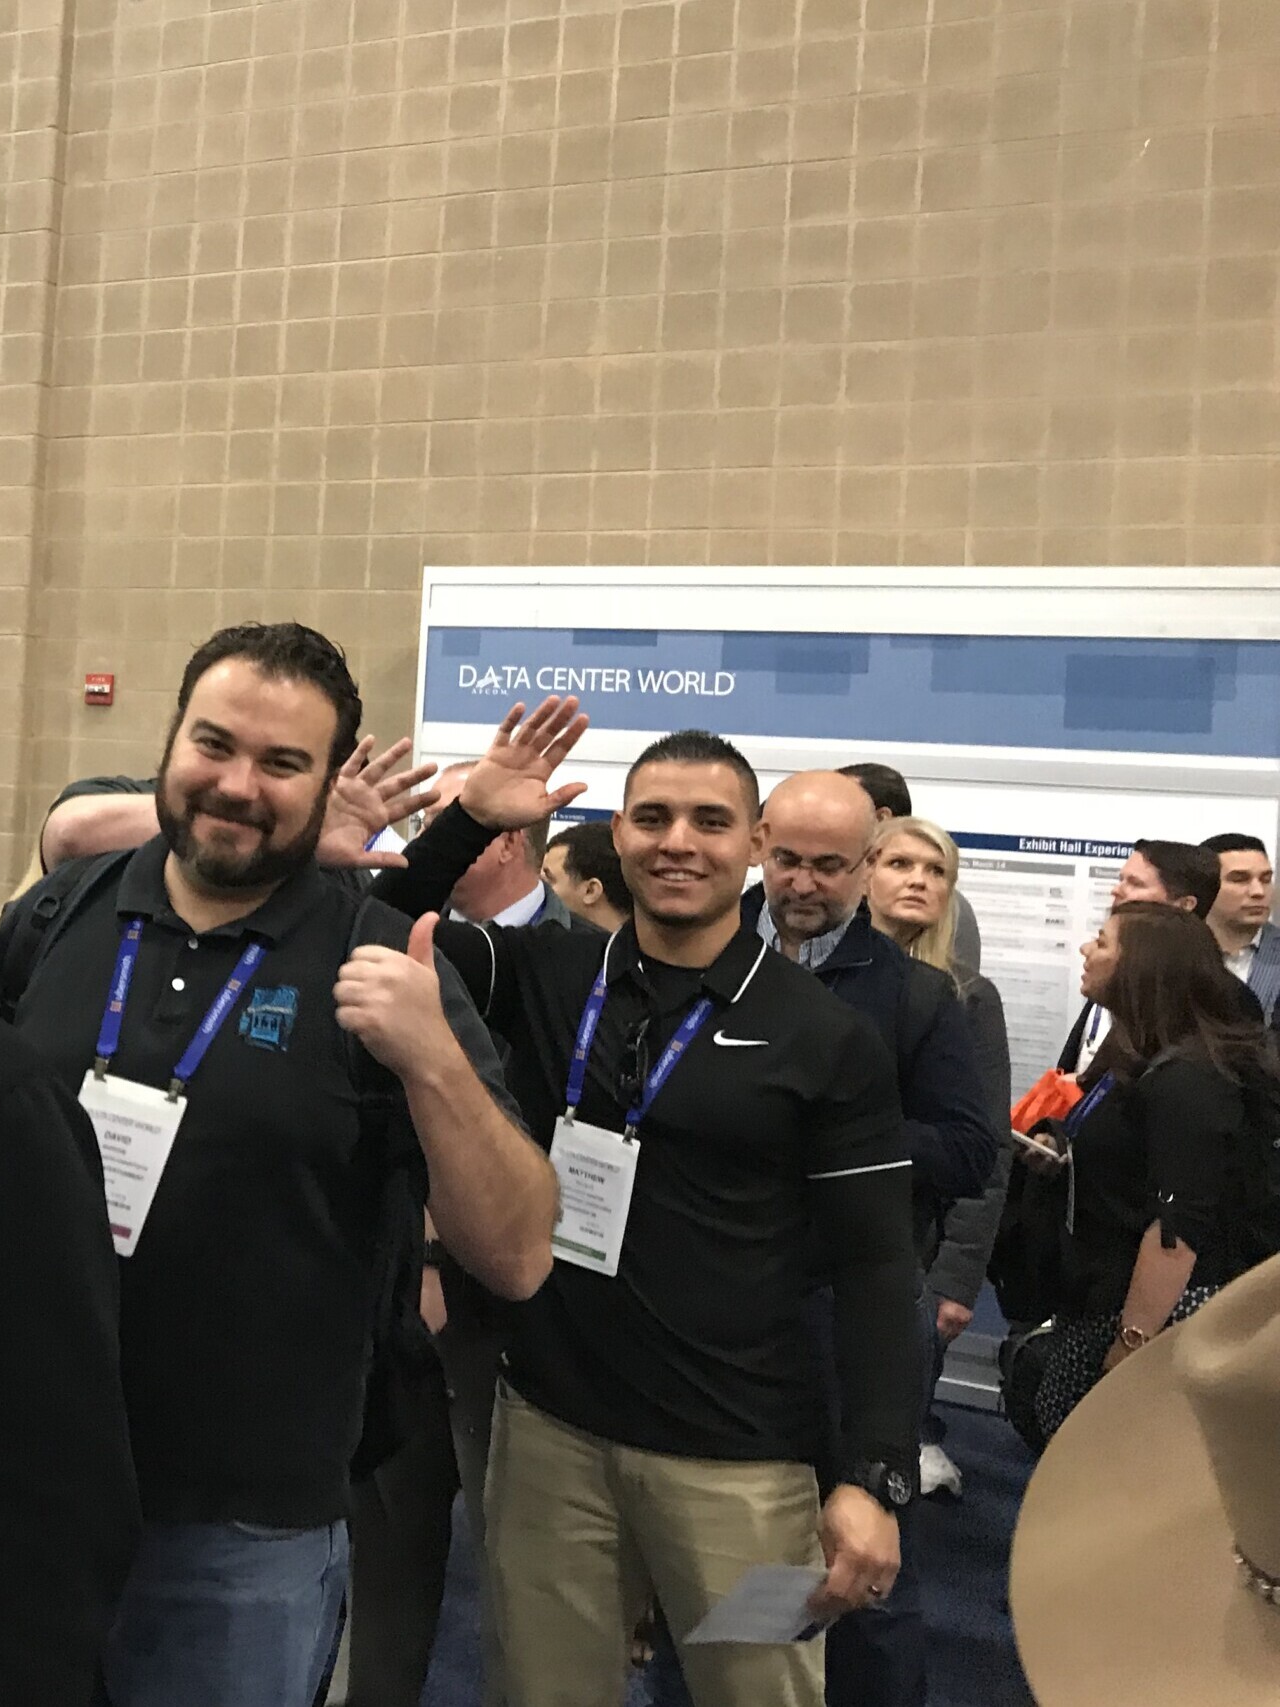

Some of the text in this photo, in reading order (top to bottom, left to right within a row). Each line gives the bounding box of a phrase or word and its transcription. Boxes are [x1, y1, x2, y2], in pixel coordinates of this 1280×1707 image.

[458, 664, 735, 696] DATA CENTER WORLD
[1019, 838, 1057, 851] Exhibit
[1060, 840, 1081, 853] Hall
